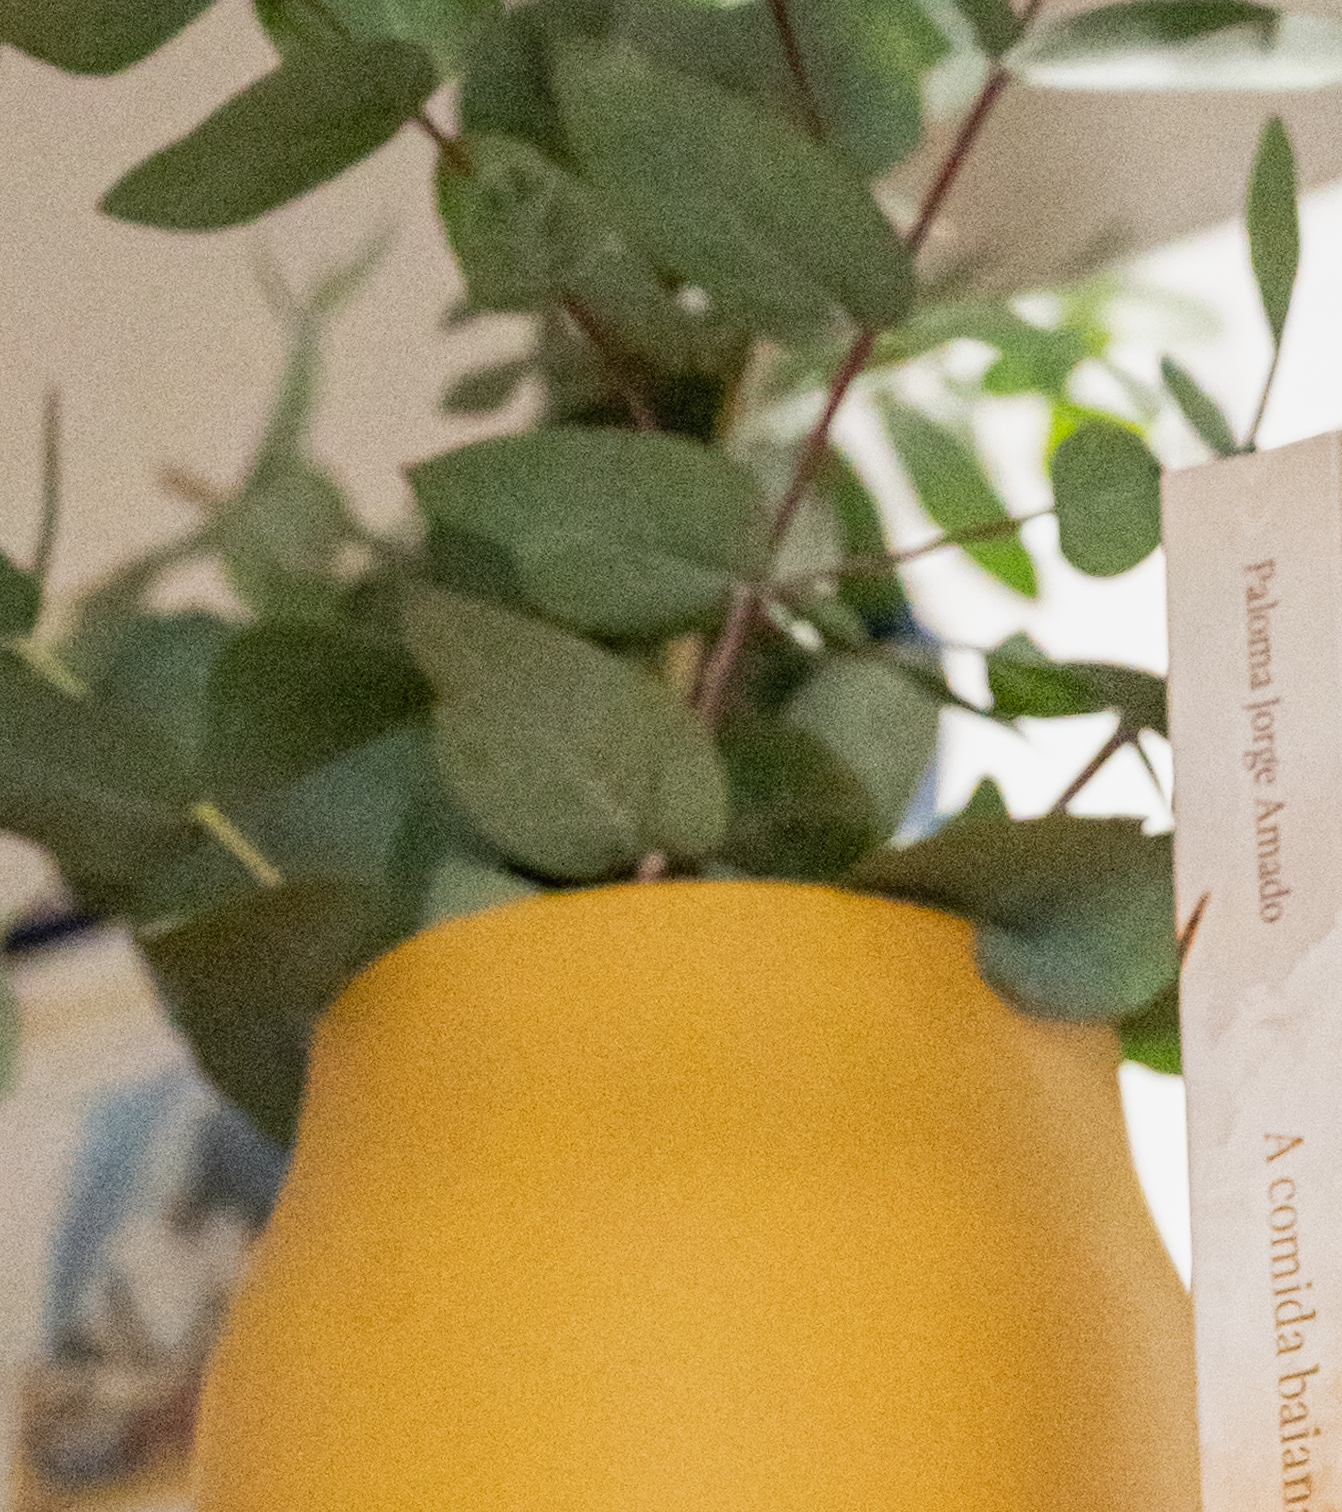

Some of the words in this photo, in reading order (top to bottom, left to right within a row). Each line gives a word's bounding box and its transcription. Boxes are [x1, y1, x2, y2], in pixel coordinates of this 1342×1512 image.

[1243, 557, 1279, 691] Paloma
[1242, 696, 1283, 786] Jorge
[1255, 797, 1294, 925] Amado
[1263, 1131, 1305, 1164] A
[1267, 1176, 1319, 1357] comida
